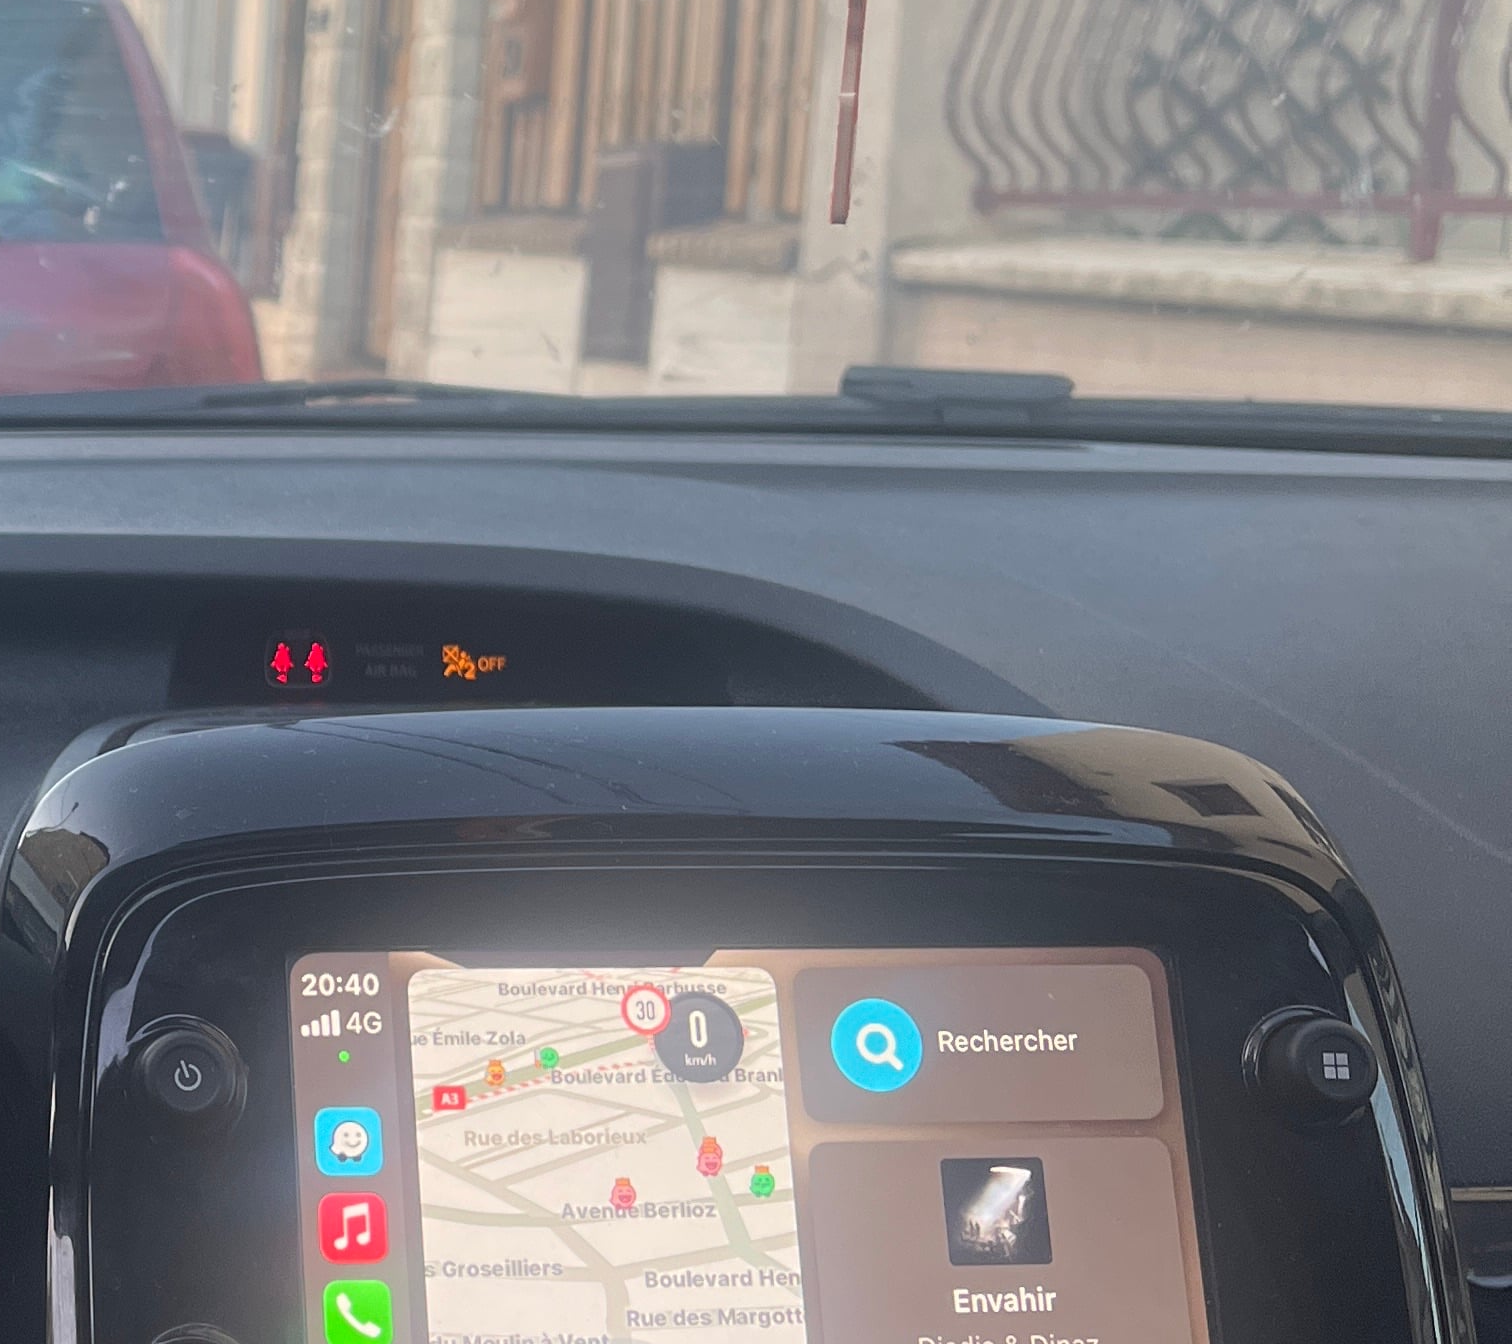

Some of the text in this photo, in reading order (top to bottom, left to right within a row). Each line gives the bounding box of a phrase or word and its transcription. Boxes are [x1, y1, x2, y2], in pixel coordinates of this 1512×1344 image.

[477, 656, 506, 673] OFF
[301, 973, 380, 997] 20:40
[498, 982, 587, 997] Boulevard
[635, 1000, 656, 1021] 30
[346, 1010, 383, 1034] 4G
[688, 1010, 707, 1049] 0
[433, 1027, 481, 1046] Émile
[486, 1030, 527, 1046] Zola
[937, 1029, 1078, 1054] Rechercher
[684, 1054, 717, 1067] km/h
[551, 1068, 646, 1085] Boulevard
[441, 1092, 459, 1105] A3
[464, 1128, 648, 1147] Rue des Laborieux
[561, 1202, 718, 1220] Avenue Berlioz
[442, 1259, 564, 1278] Groseilliers
[645, 1270, 753, 1288] Boulevard
[953, 1287, 1057, 1314] Envahir
[627, 1310, 667, 1327] Rue
[673, 1309, 713, 1326] des
